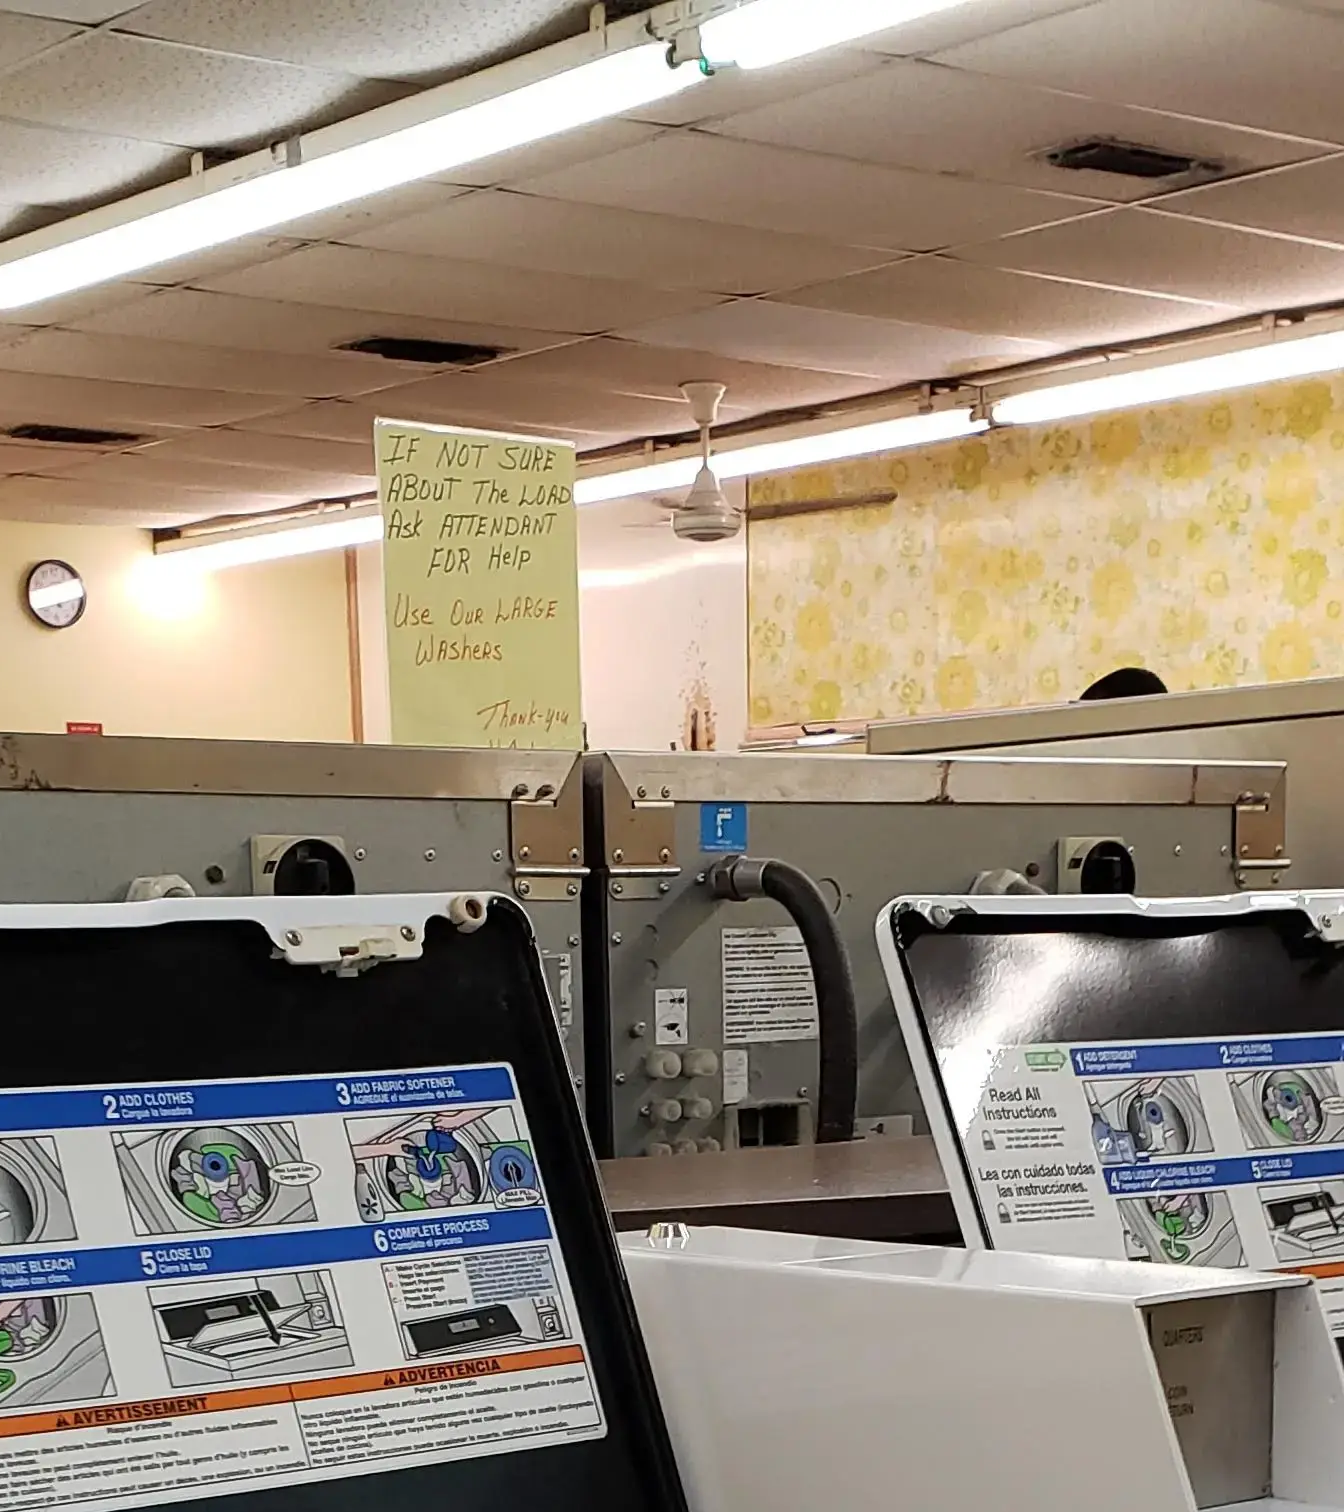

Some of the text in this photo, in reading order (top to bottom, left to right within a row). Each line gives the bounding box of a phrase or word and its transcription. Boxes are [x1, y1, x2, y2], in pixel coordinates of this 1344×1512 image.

[383, 435, 556, 471] IF NOT SURE
[519, 484, 571, 507] LOAD
[439, 513, 557, 540] ATTENDANT
[427, 548, 471, 577] FOR
[394, 593, 433, 627] Use
[496, 597, 558, 623] LARGE
[1220, 1045, 1230, 1064] 2
[336, 1076, 455, 1105] 3 ADD FABRIC SOFTENER
[989, 1087, 1041, 1102] Read All
[103, 1092, 194, 1119] 2 ADD CLOTHES
[983, 1105, 1057, 1120] Instructions
[978, 1162, 1095, 1181] Lea con cuidado todas
[1111, 1171, 1120, 1190] 4
[1251, 1161, 1262, 1178] 5
[997, 1184, 1013, 1198] las
[374, 1219, 489, 1251] 6 COMPLETE PROCESS
[30, 1258, 75, 1273] BLEACH
[141, 1247, 211, 1275] 5 CLOSE LID
[399, 1359, 501, 1384] ADVERTENCIA
[74, 1397, 207, 1425] AVERTISSEMENT
